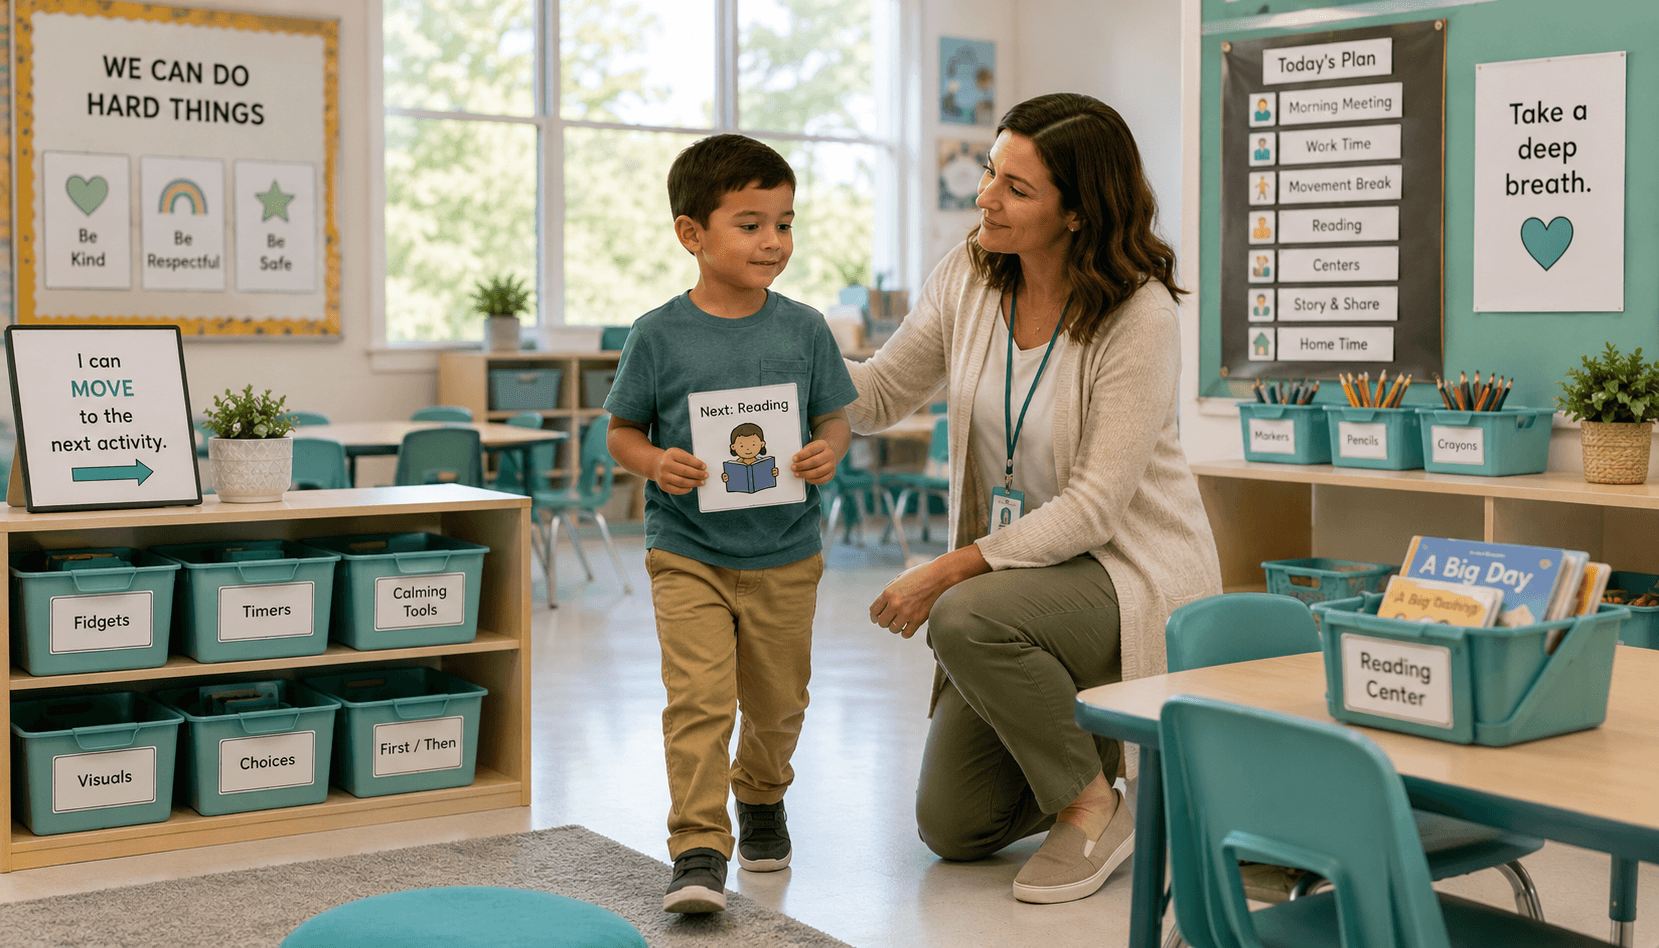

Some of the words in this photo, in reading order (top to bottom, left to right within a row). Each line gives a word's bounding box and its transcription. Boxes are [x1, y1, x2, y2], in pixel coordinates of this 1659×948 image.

[102, 55, 142, 80] WE
[151, 59, 203, 84] CAN
[213, 63, 250, 87] DO
[1277, 53, 1336, 75] Today's
[1341, 50, 1376, 68] Plan
[87, 92, 160, 119] HARD
[169, 97, 265, 126] THINGS
[1289, 101, 1338, 115] Morning
[1342, 97, 1392, 112] Meeting
[1509, 100, 1564, 125] Take
[1572, 104, 1587, 121] a
[1306, 140, 1338, 153] Work
[1341, 137, 1372, 151] Time
[1518, 136, 1578, 165] deep
[1289, 180, 1351, 193] Movement
[1356, 175, 1392, 191] Break
[1505, 169, 1592, 196] breath.
[1312, 218, 1362, 235] Reading
[78, 228, 98, 244] Be
[174, 230, 193, 246] Be
[267, 233, 285, 249] Be
[71, 252, 105, 267] Kind
[147, 253, 220, 271] Respectful
[260, 255, 292, 271] Safe
[1313, 258, 1360, 272] Centers
[1294, 297, 1327, 314] Story
[1330, 297, 1339, 311] &
[1343, 296, 1380, 311] Share
[1300, 337, 1335, 351] Home
[1338, 337, 1368, 351] Time
[77, 352, 83, 369] I
[89, 356, 121, 369] can
[70, 379, 135, 398] MOVE
[79, 409, 99, 425] to
[103, 407, 133, 424] the
[700, 404, 734, 418] Next:
[737, 399, 789, 414] Reading
[51, 436, 92, 453] next
[97, 433, 167, 453] activity.
[1254, 430, 1289, 441] Markers
[1347, 434, 1379, 446] Pencils
[1437, 438, 1478, 453] Crayons
[1419, 554, 1437, 576] A
[1442, 556, 1481, 586] Big
[1485, 561, 1534, 594] Day
[393, 585, 447, 600] Calming
[242, 605, 292, 618] Timers
[403, 603, 438, 618] Tools
[74, 614, 130, 632] Fidgets
[1360, 652, 1431, 684] Reading
[1366, 680, 1426, 706] Center
[380, 741, 410, 756] First
[413, 738, 421, 753] /
[423, 737, 456, 751] Then
[239, 755, 296, 770] Choices
[77, 769, 133, 788] Visuals
